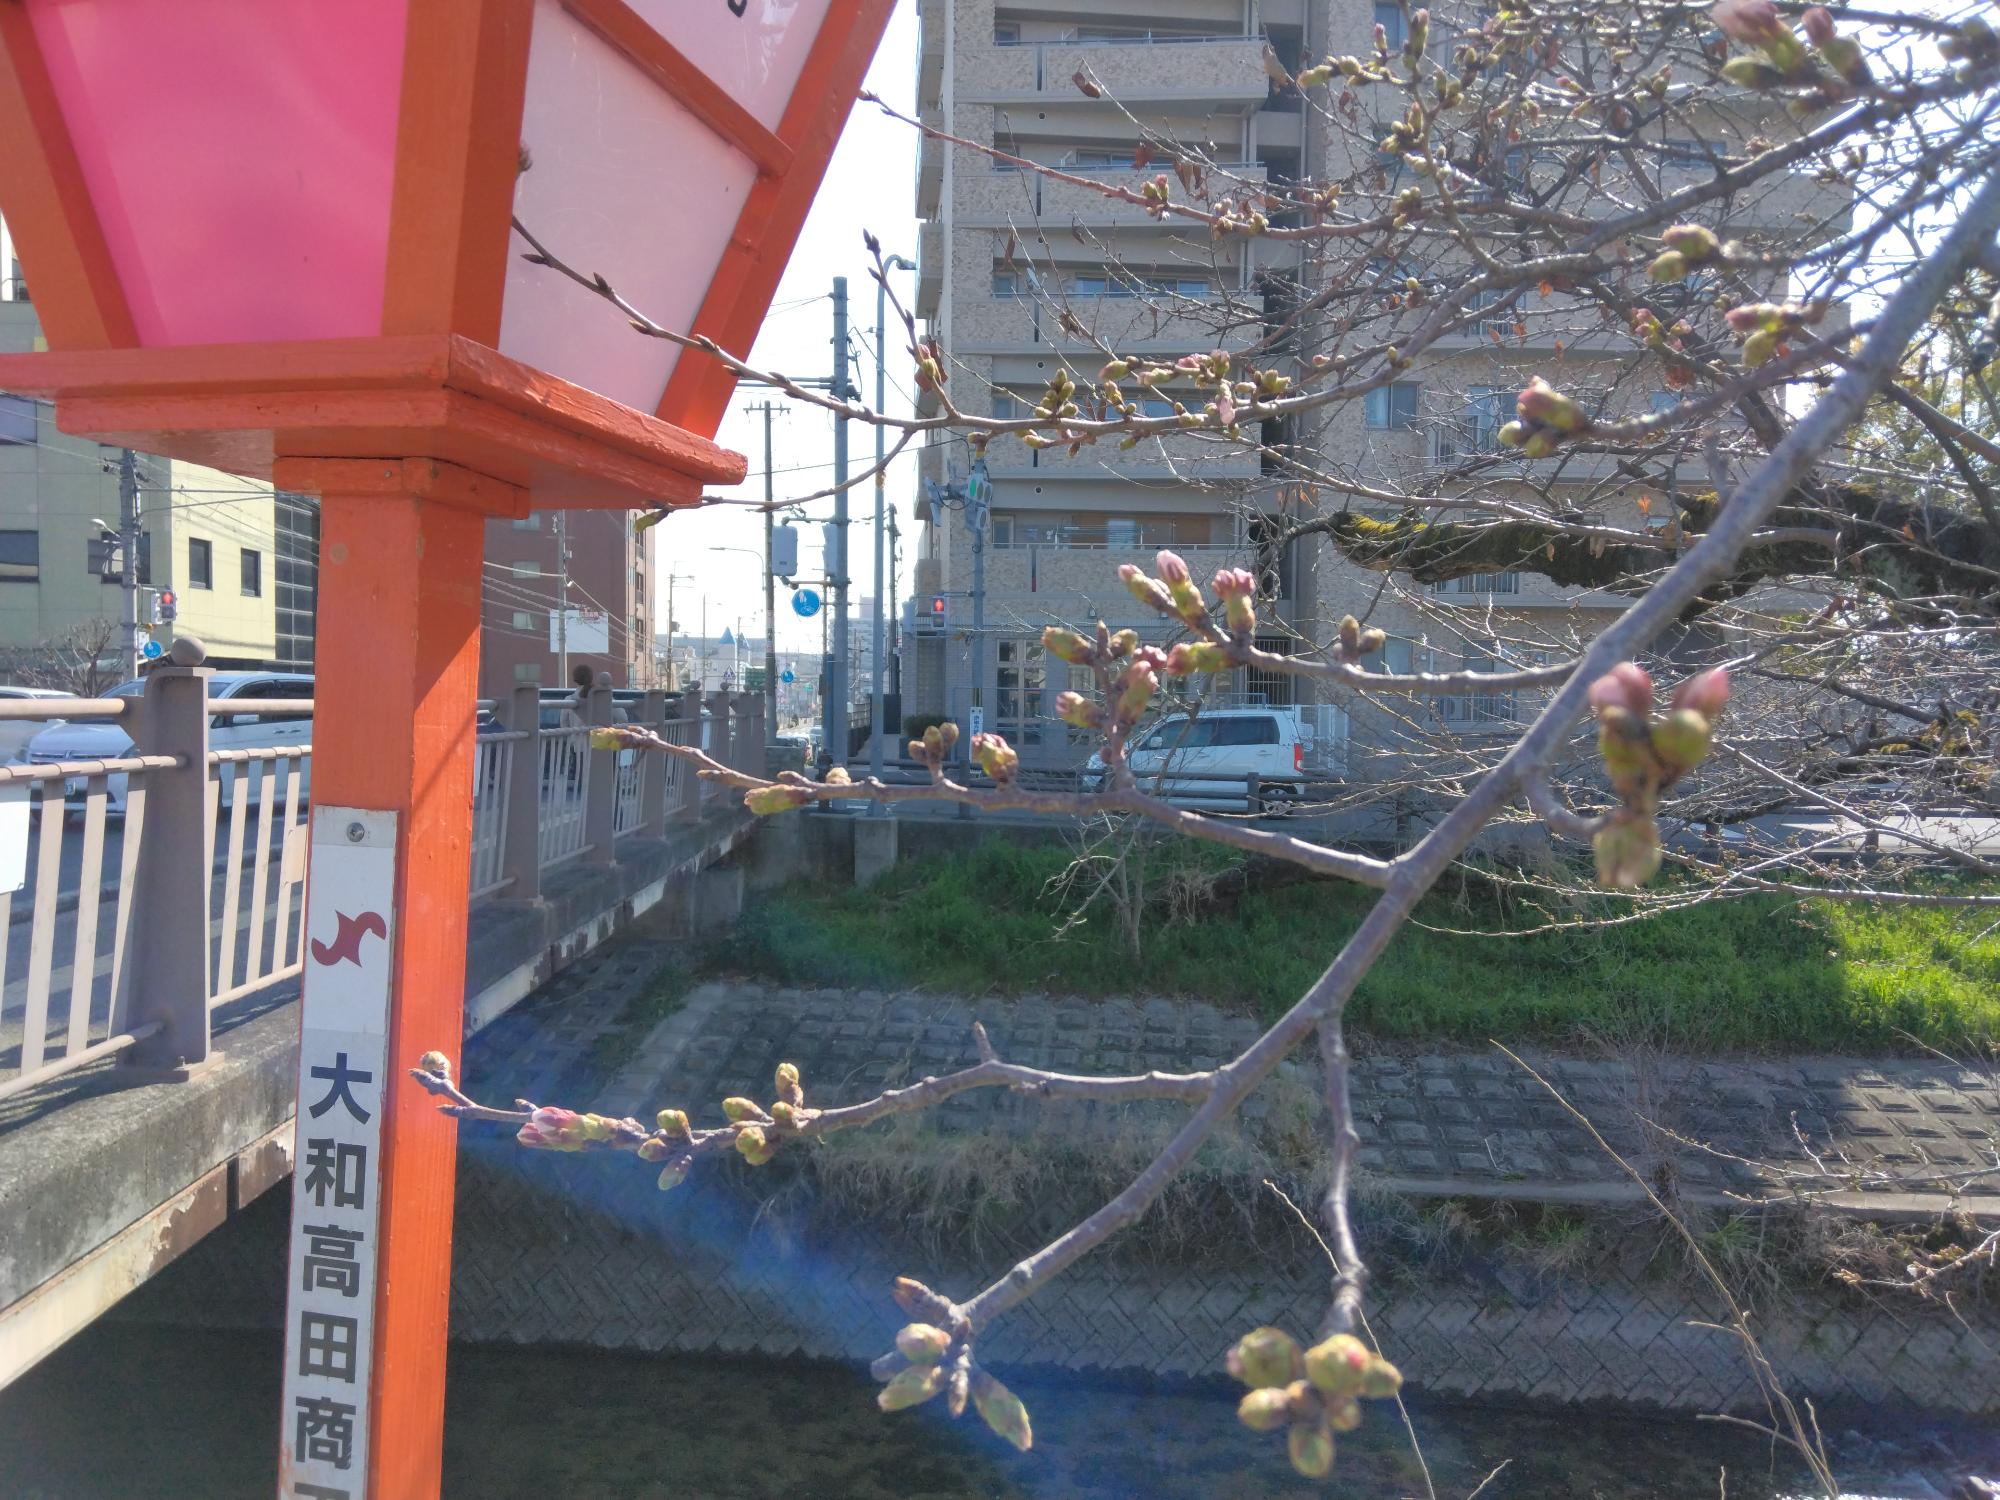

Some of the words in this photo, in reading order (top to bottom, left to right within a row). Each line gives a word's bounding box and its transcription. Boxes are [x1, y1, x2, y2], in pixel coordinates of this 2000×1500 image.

[294, 1052, 372, 1500] 大和高田商
